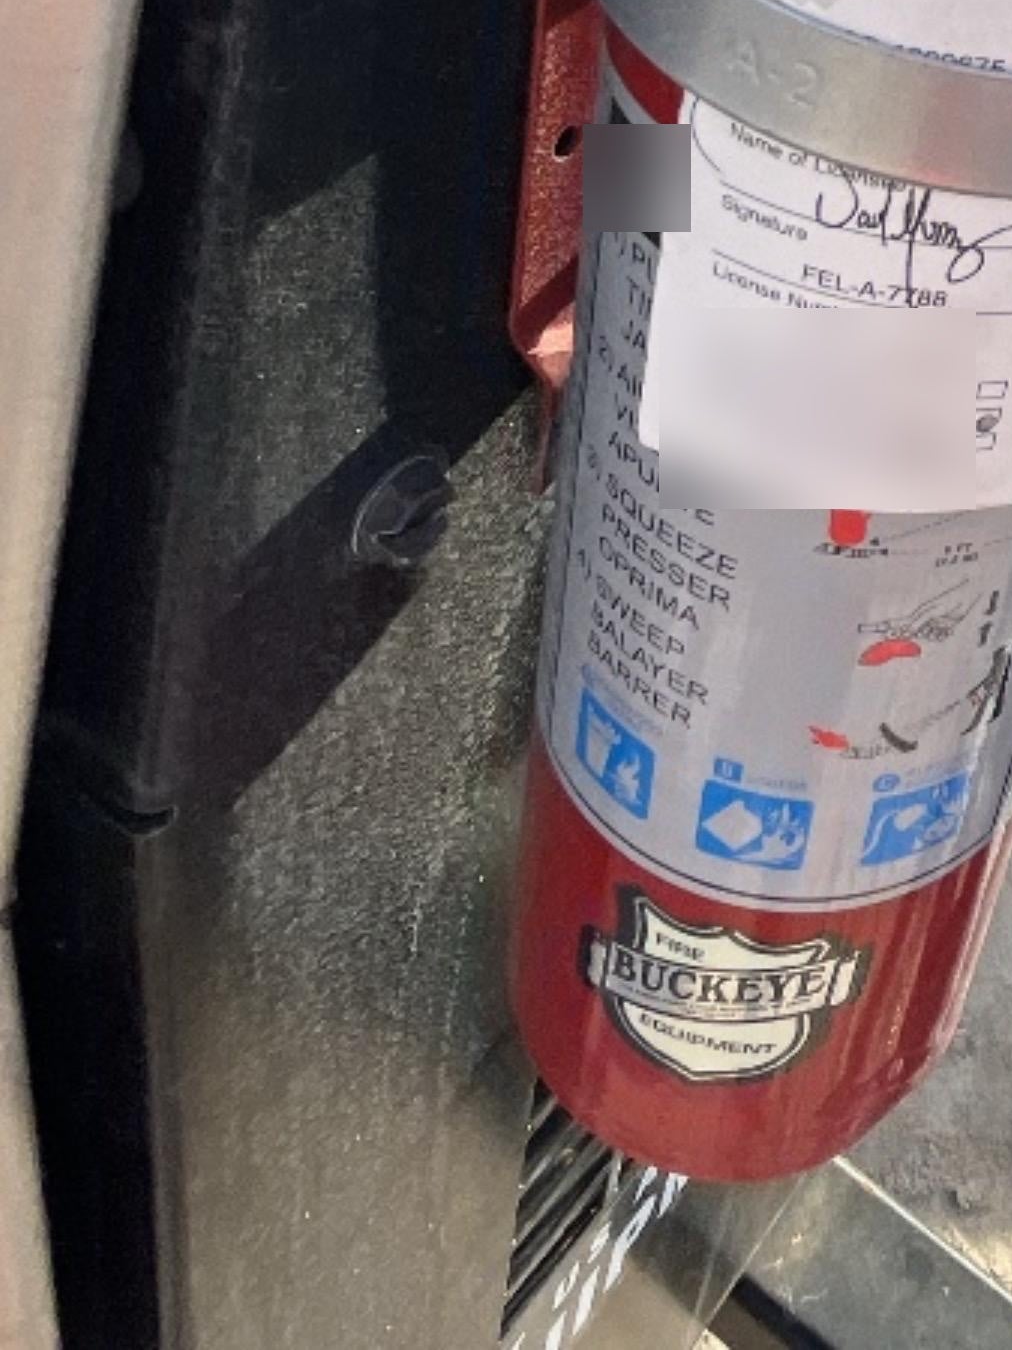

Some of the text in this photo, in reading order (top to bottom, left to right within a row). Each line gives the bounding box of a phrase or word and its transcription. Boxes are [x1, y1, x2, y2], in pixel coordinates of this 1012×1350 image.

[731, 121, 783, 158] Name
[722, 193, 808, 242] Signature
[713, 264, 781, 302] License
[601, 504, 731, 613] PRESSER
[605, 473, 739, 581] SQUEEZE
[599, 536, 700, 631] OPRIMA
[586, 629, 692, 731] BARRER
[591, 600, 709, 707] BALAYER
[612, 949, 828, 1002] BUCKEYE
[638, 1012, 776, 1054] EQUIPMENT
